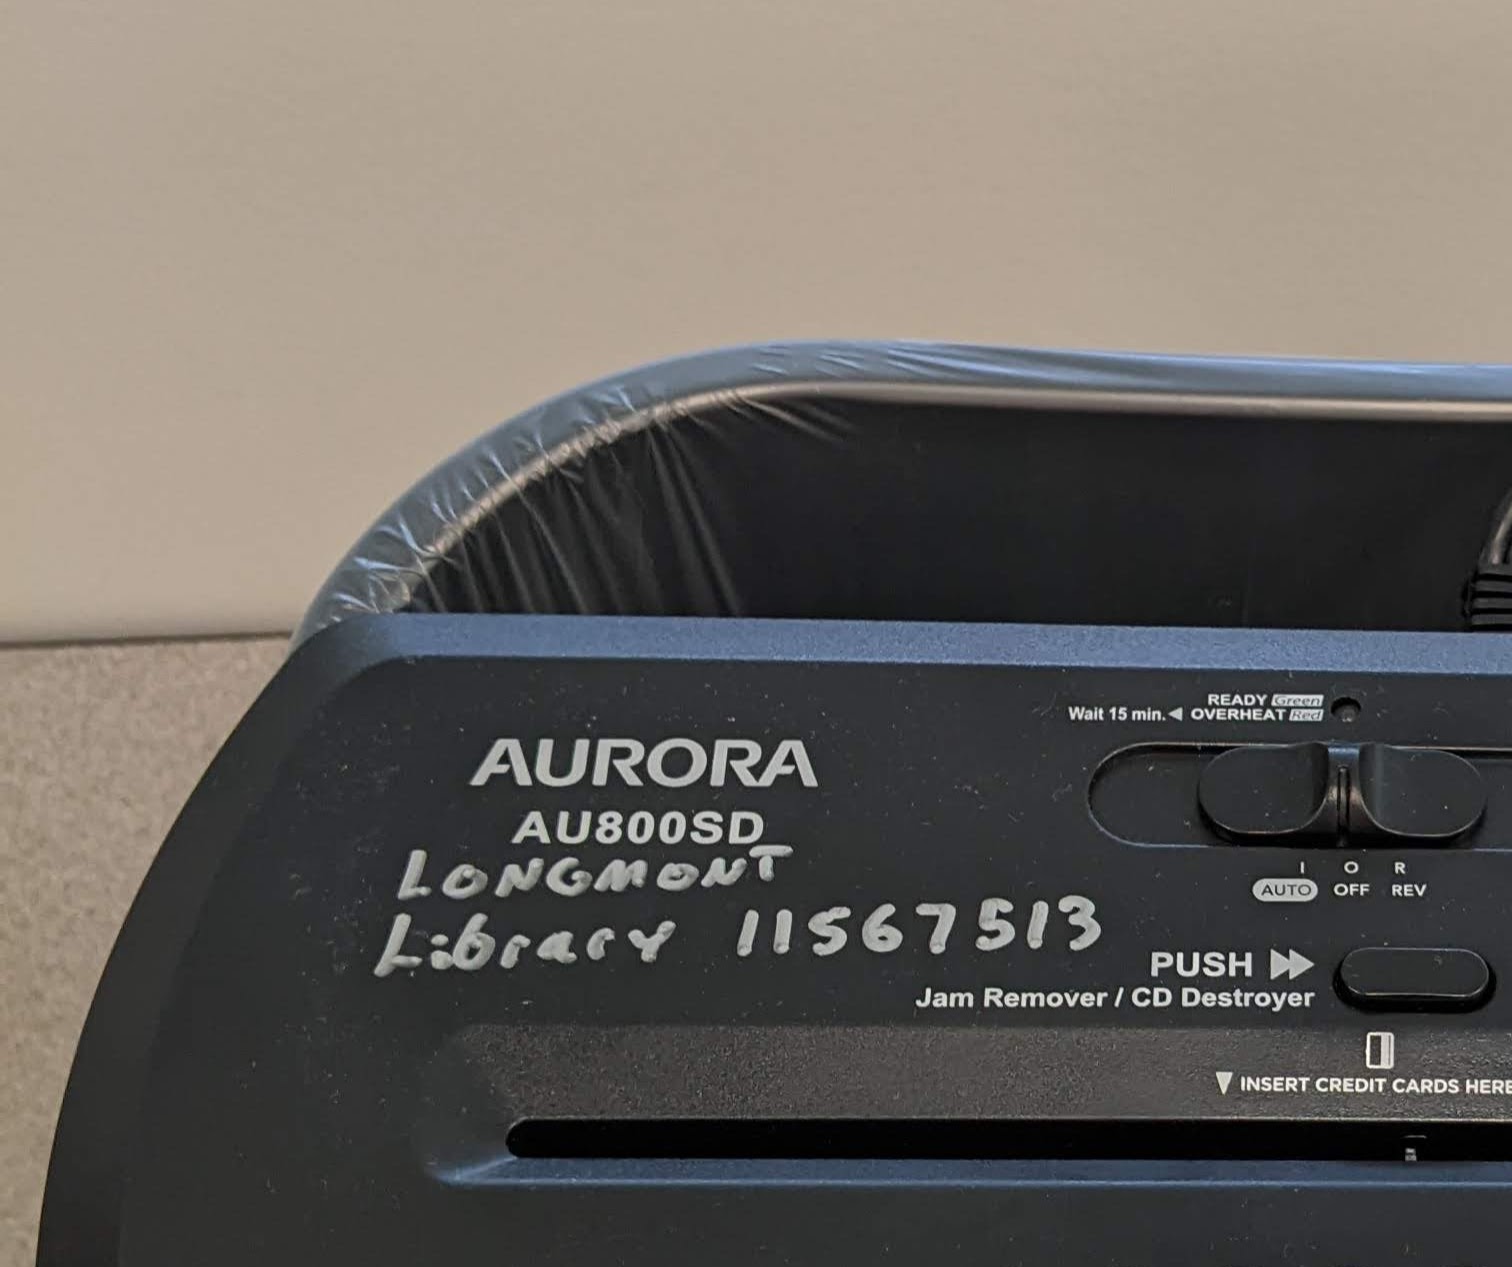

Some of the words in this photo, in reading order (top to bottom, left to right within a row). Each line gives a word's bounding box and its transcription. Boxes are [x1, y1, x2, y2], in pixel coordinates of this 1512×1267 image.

[1208, 694, 1267, 706] READY
[1069, 707, 1103, 720] Wait
[1110, 707, 1127, 720] 15
[1132, 707, 1166, 720] min.
[1191, 708, 1286, 720] OVERHEAT
[470, 738, 818, 787] AURORA
[512, 811, 763, 843] AU800SD
[398, 845, 793, 899] LONGMONT
[1395, 862, 1405, 874] R
[1260, 883, 1312, 898] AUTO
[1334, 884, 1369, 896] OFF
[1392, 884, 1426, 896] REV
[374, 913, 676, 976] Library
[737, 895, 1101, 956] 11567513
[1151, 952, 1252, 977] PUSH
[916, 988, 973, 1007] Jam
[984, 988, 1108, 1007] Remover
[1132, 987, 1172, 1007] CD
[1182, 988, 1315, 1011] Destroyer
[1241, 1077, 1310, 1092] INSERT
[1316, 1078, 1386, 1092] CREDIT
[1392, 1079, 1459, 1093] CARDS
